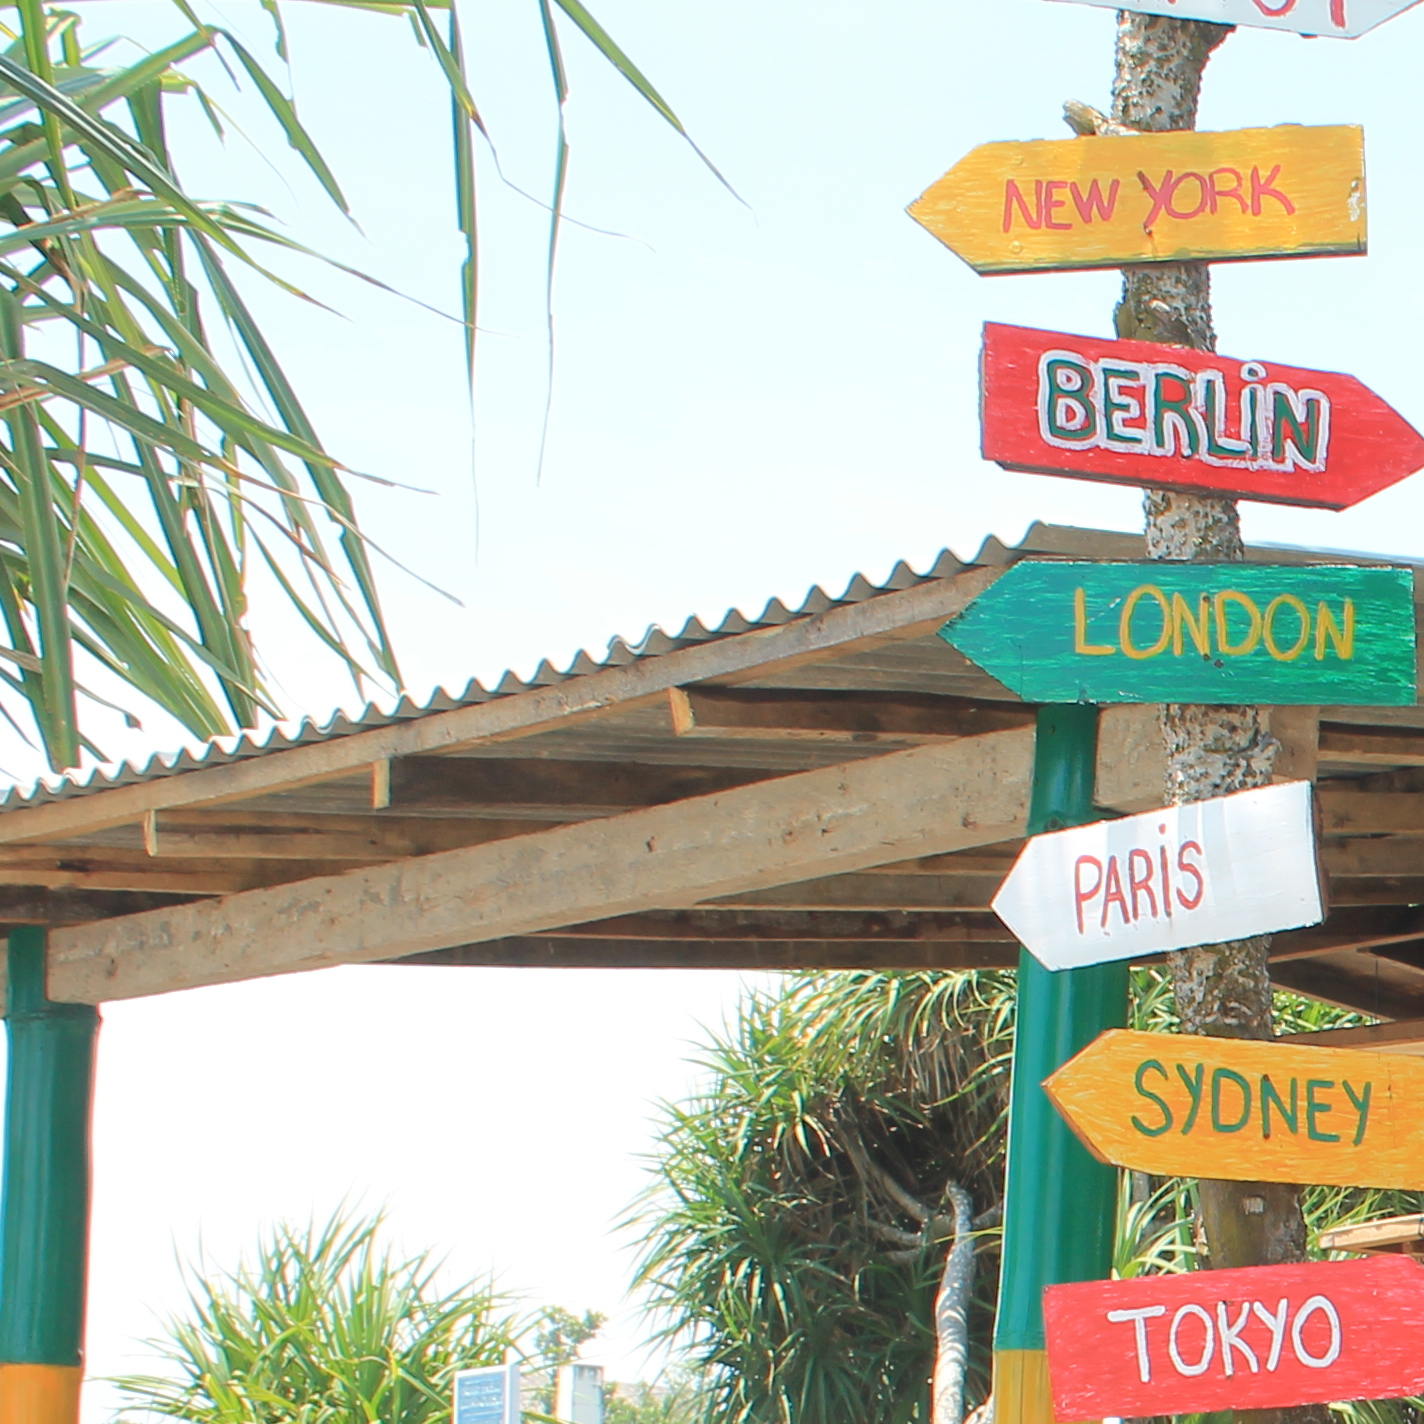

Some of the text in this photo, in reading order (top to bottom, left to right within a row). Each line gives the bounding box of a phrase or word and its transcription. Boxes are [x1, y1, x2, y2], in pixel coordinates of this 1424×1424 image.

[1002, 163, 1296, 236] NEW YORK
[1074, 584, 1355, 661] LONDON
[1130, 1058, 1373, 1147] SYDNEY
[1106, 1294, 1343, 1384] TOKYO
